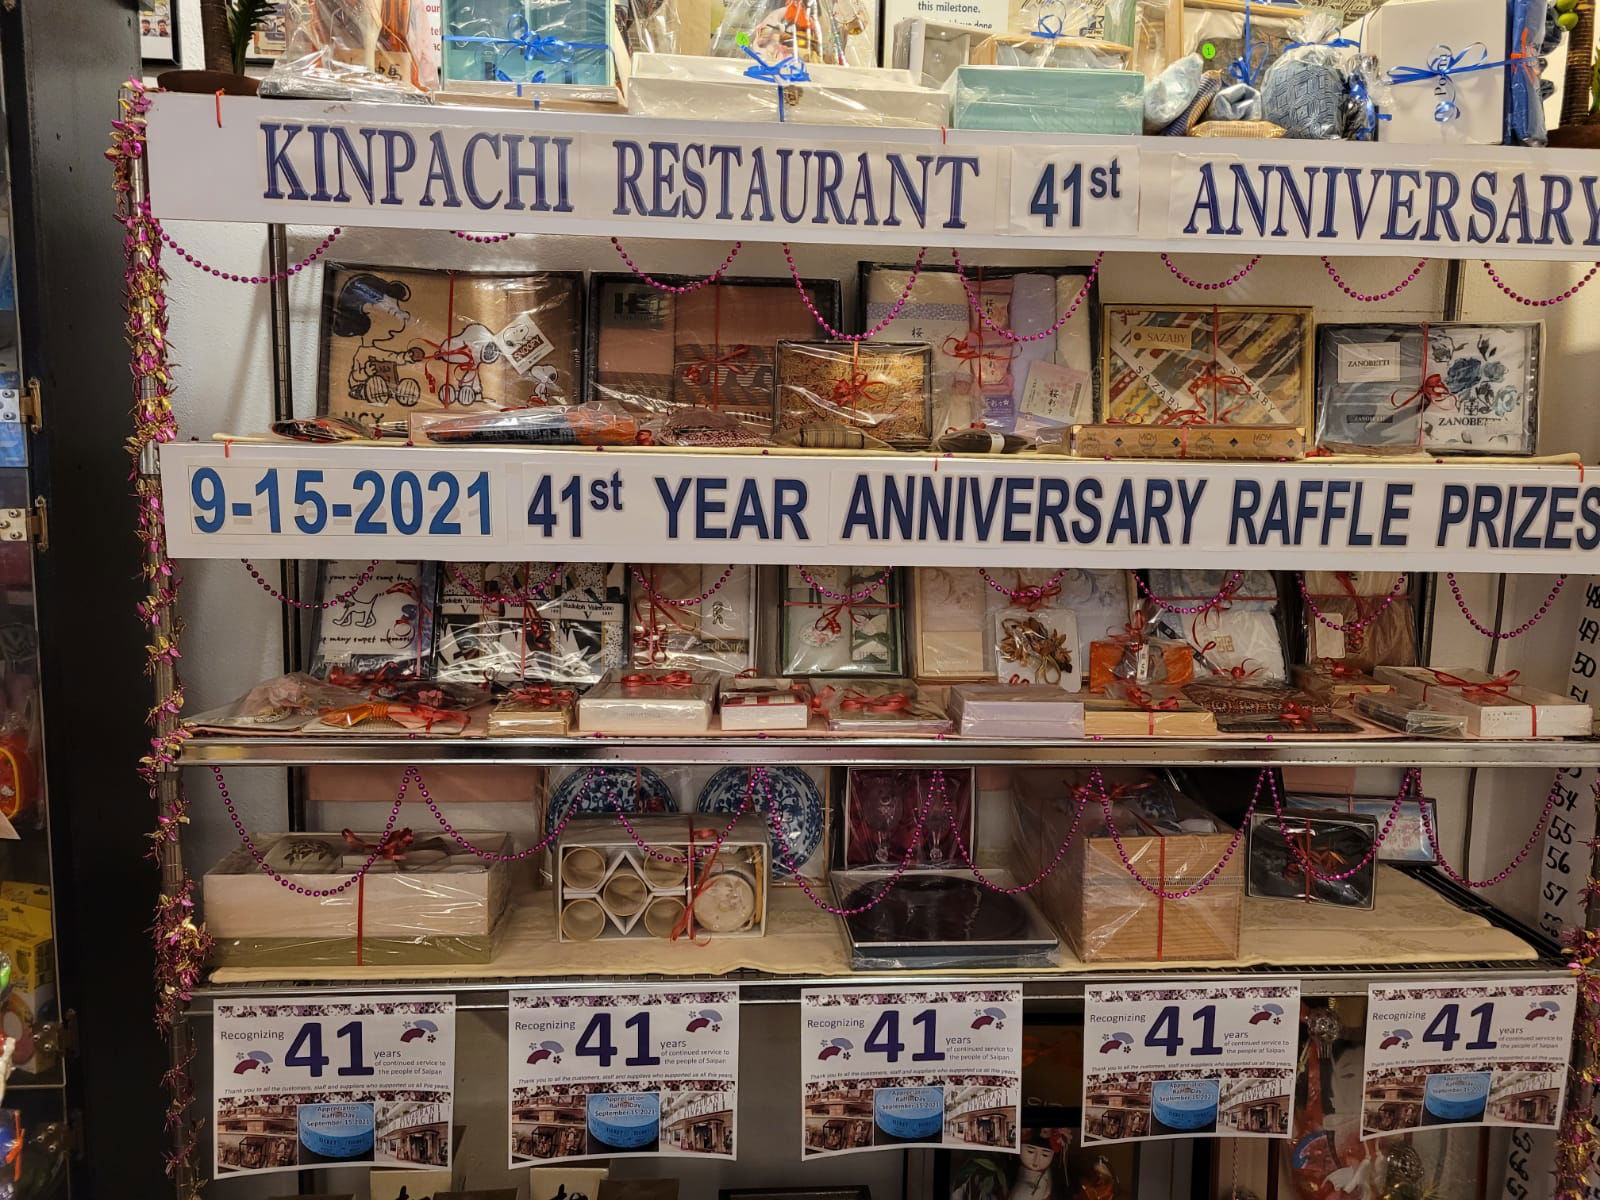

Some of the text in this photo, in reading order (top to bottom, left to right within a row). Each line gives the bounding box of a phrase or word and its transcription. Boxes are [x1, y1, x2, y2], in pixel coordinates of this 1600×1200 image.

[918, 2, 980, 13] this milestone.
[260, 123, 1600, 246] KINPACHI RESTAURANT 41st ANNIVERSARY
[513, 334, 541, 360] SNOOPY
[1148, 332, 1187, 343] SAZABY
[1136, 365, 1182, 411] SAZABY
[1230, 366, 1276, 412] SAABY
[191, 467, 1600, 551] 9-15-2021 41st YEAR ANNIVERSARY RAFFLE PRIZES
[1579, 617, 1599, 644] 49
[1572, 651, 1597, 678] 50
[1554, 785, 1578, 811] 54
[1548, 815, 1576, 845] 55
[1545, 846, 1571, 875] 56
[1543, 881, 1568, 906] 57
[515, 1012, 661, 1067] Recognizing 41
[807, 1009, 946, 1063] Recognizing 41
[1090, 1005, 1223, 1056] Recognizing 41
[1224, 1032, 1249, 1040] years
[1372, 1002, 1497, 1051] Recognizing 41
[1499, 1028, 1524, 1036] years
[221, 1021, 374, 1077] Recognizing 41
[374, 1050, 401, 1059] years
[660, 1041, 687, 1049] years
[946, 1037, 972, 1045] years
[391, 1068, 412, 1076] people
[422, 1068, 443, 1076] Saipan
[1512, 1127, 1535, 1153] 65
[1509, 1151, 1529, 1181] 66
